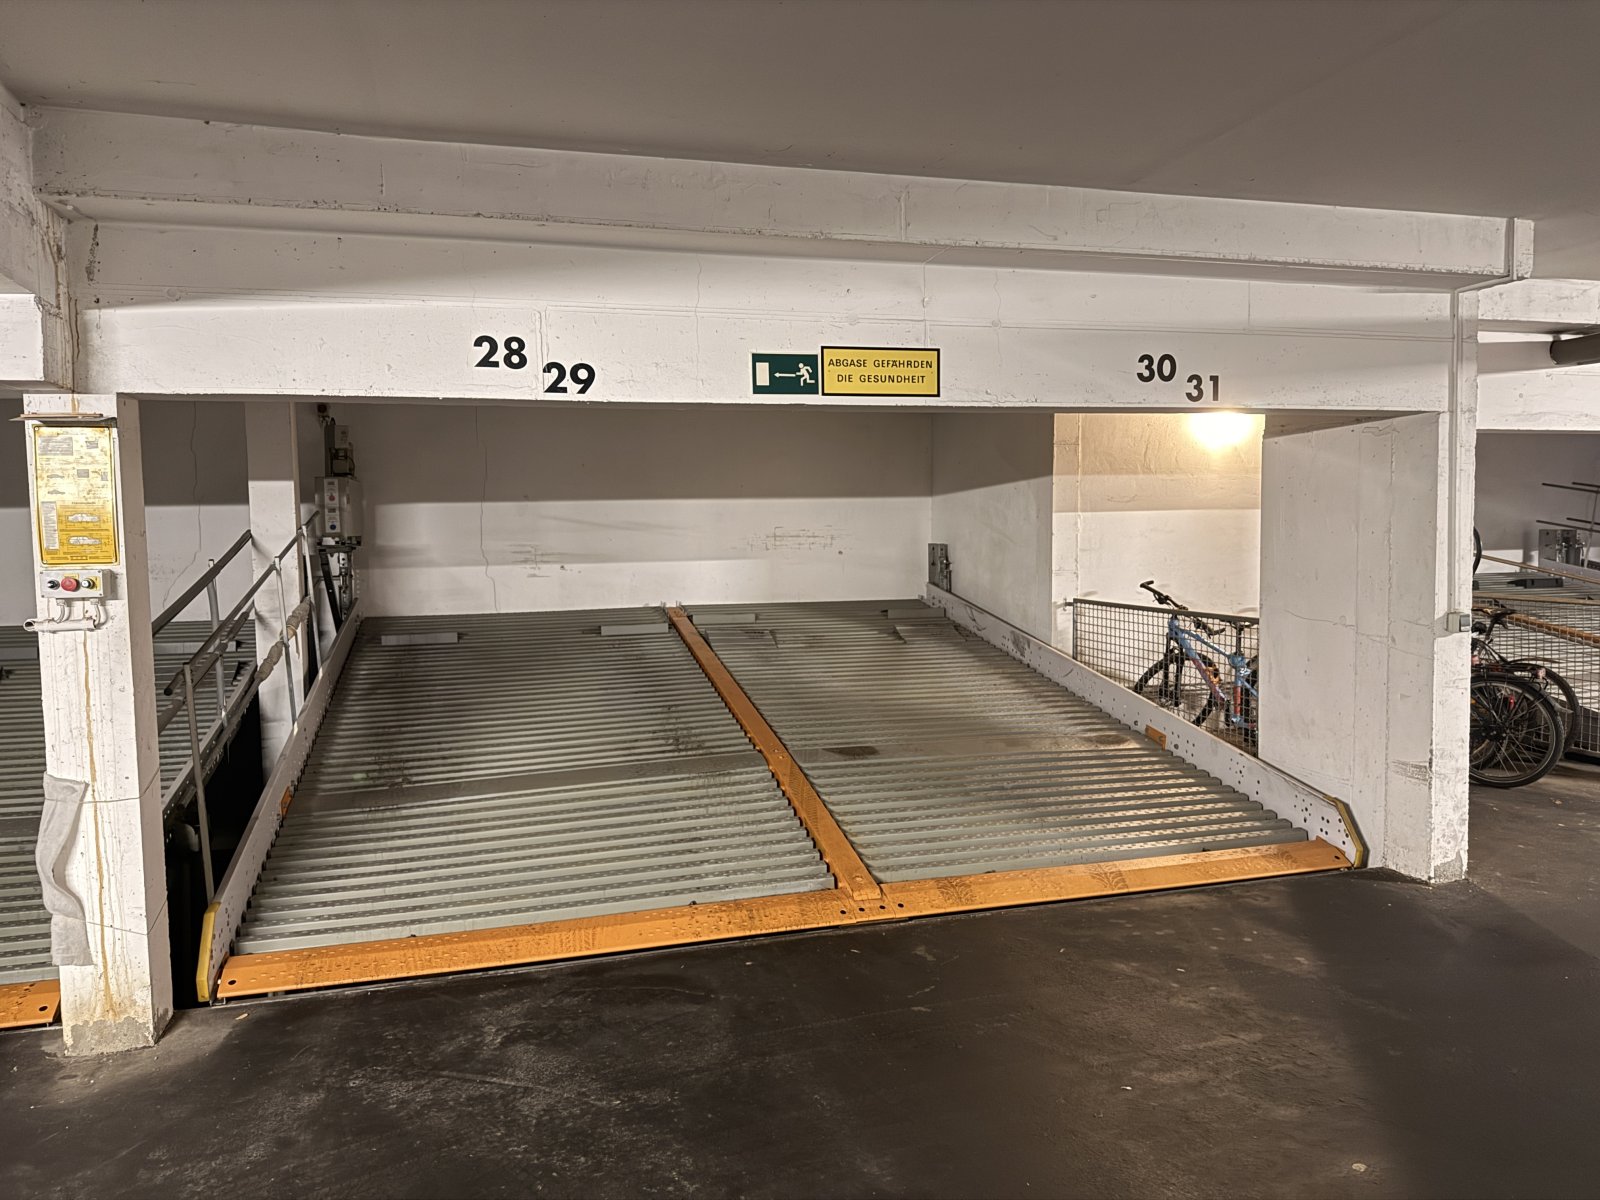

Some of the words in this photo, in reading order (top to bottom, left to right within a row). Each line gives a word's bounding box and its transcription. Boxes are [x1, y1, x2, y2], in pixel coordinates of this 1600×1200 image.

[473, 335, 528, 370] 28
[828, 358, 868, 368] ABGASE
[873, 359, 933, 369] GEFÄHRDEN
[542, 361, 596, 395] 29
[837, 374, 853, 383] DIE
[859, 374, 926, 384] GESUNDHEIT
[1136, 353, 1177, 383] 30
[1185, 374, 1219, 403] 31
